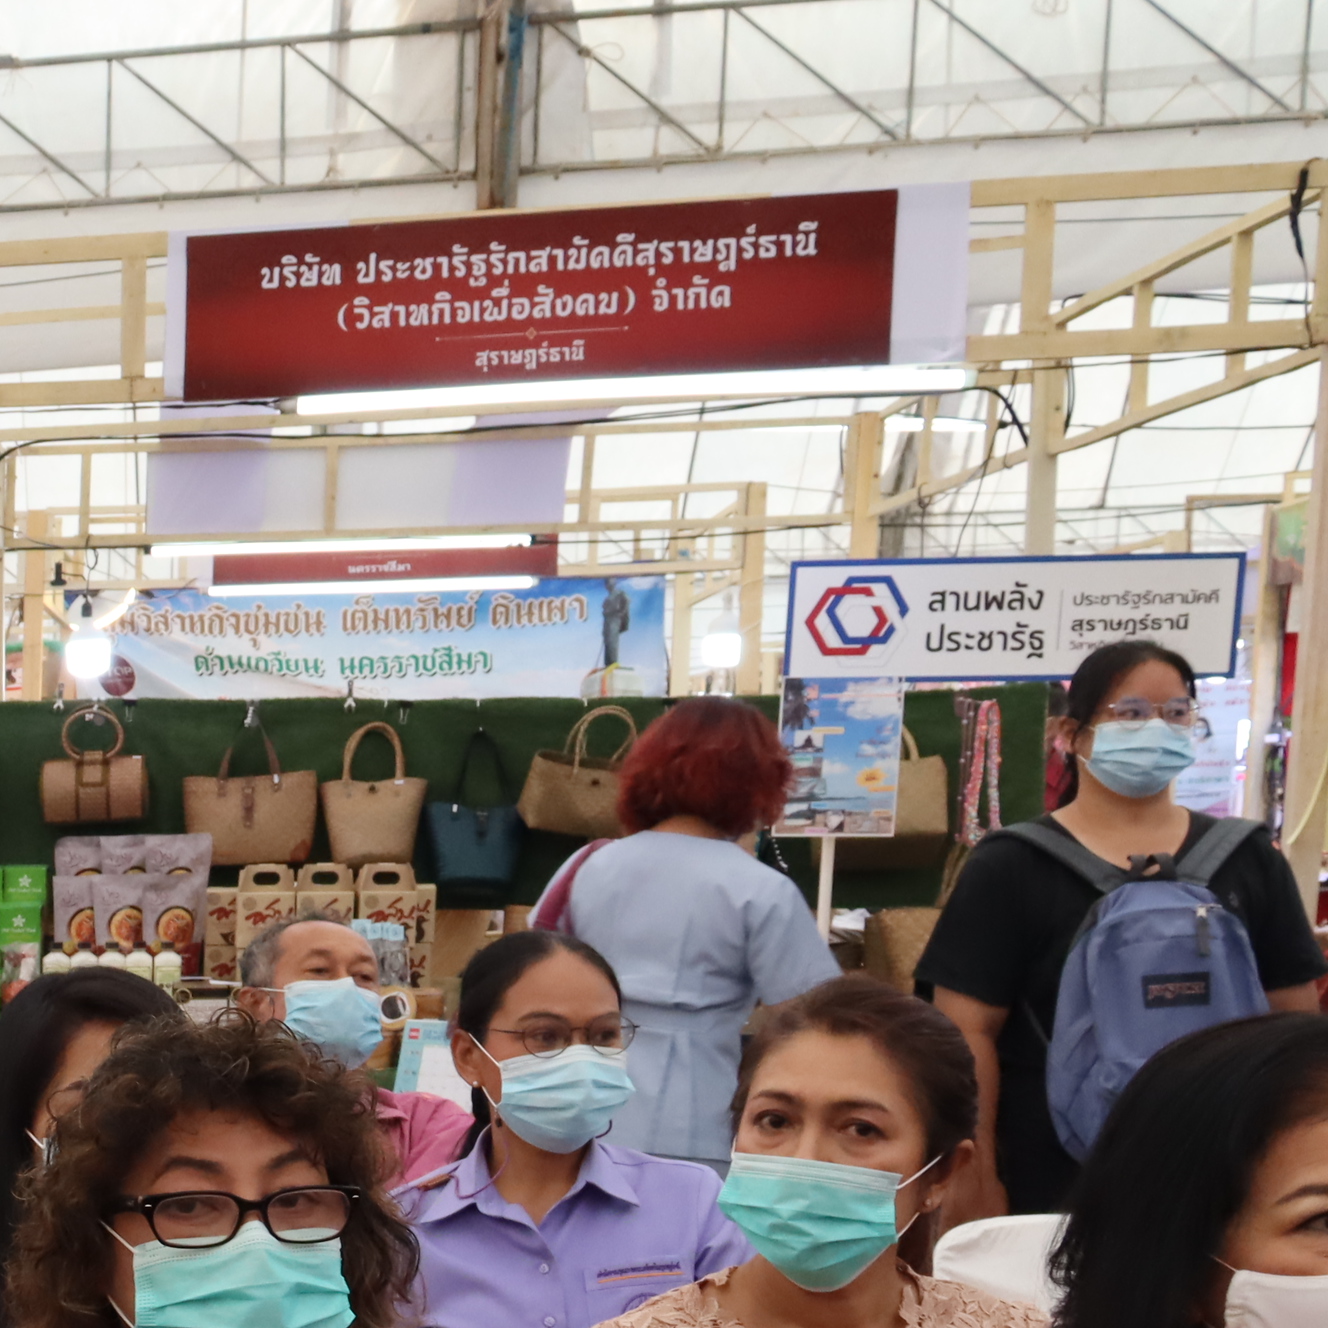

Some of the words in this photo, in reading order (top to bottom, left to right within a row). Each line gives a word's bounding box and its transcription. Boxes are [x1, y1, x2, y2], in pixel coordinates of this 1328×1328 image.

[259, 253, 342, 291] บริษัท
[355, 221, 819, 289] ประชารัฐรักสามัคคีสุราษฎร์ธานี
[335, 278, 637, 332] (วิสาหกิจเพื่อสังคม)
[652, 276, 733, 314] จำกัด
[474, 340, 585, 374] สุราษฎร์ธานี
[490, 592, 588, 628] ดินเผา
[928, 582, 1044, 612] สานพลัง
[1073, 588, 1220, 609] ประชารัฐรักสามัคคี
[925, 622, 1045, 659] ประชารัฐ
[1071, 613, 1189, 637] สุราษฎร์ธานี
[339, 646, 492, 679] นครราชสีมา
